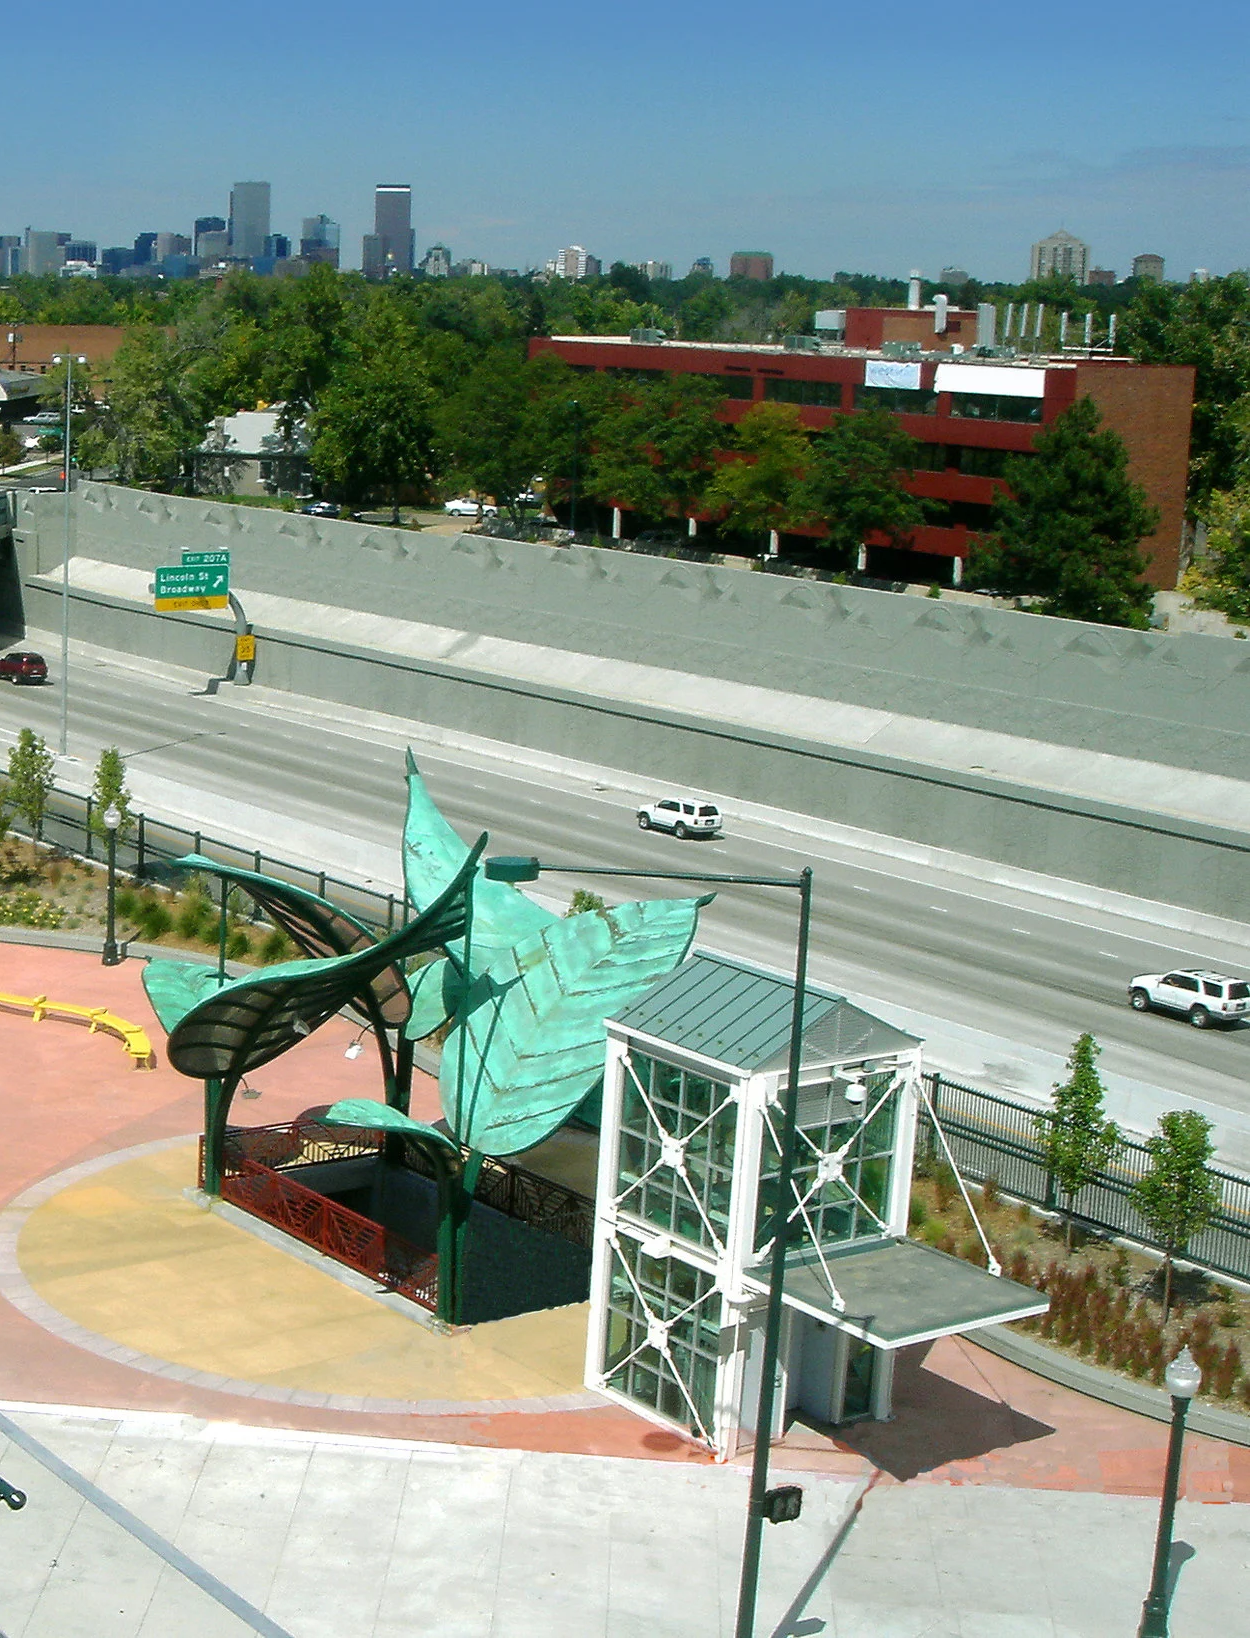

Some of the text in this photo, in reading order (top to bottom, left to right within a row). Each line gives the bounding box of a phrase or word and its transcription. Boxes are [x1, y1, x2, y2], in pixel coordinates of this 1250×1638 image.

[203, 553, 227, 563] 207A
[160, 571, 209, 582] Lincoln St
[160, 584, 207, 594] Broadway
